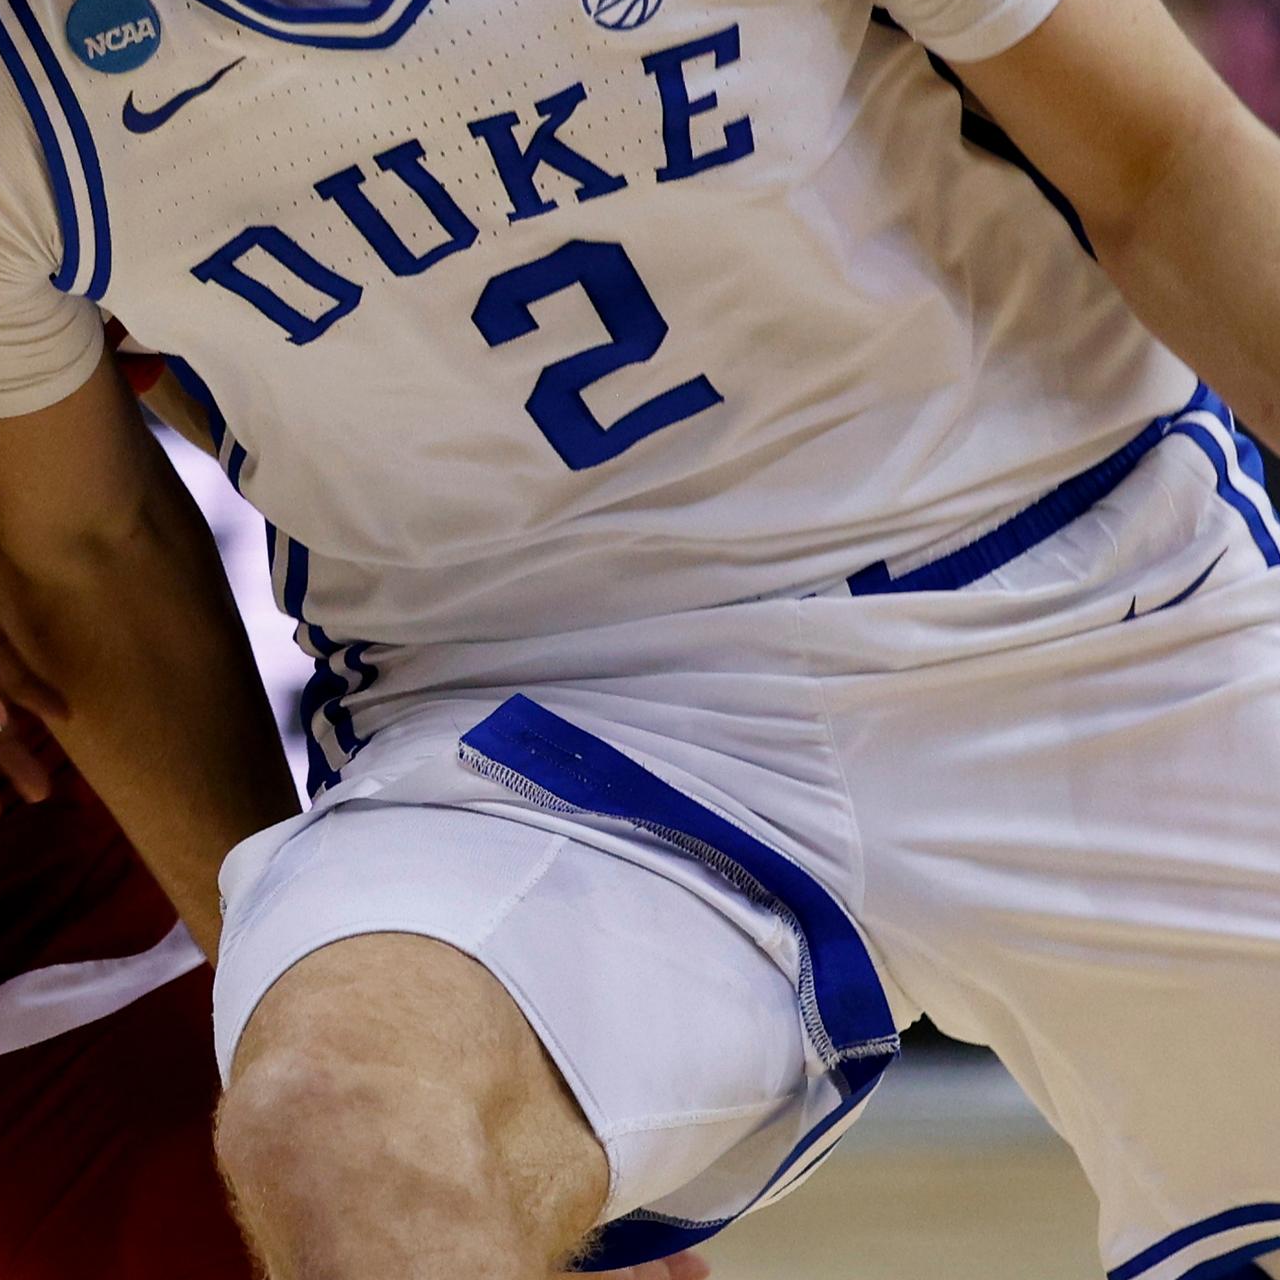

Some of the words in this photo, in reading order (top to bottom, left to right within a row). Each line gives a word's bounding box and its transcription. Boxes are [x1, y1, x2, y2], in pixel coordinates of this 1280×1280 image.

[83, 17, 157, 60] NCAA
[189, 23, 756, 348] DUKE
[470, 238, 725, 472] 2
